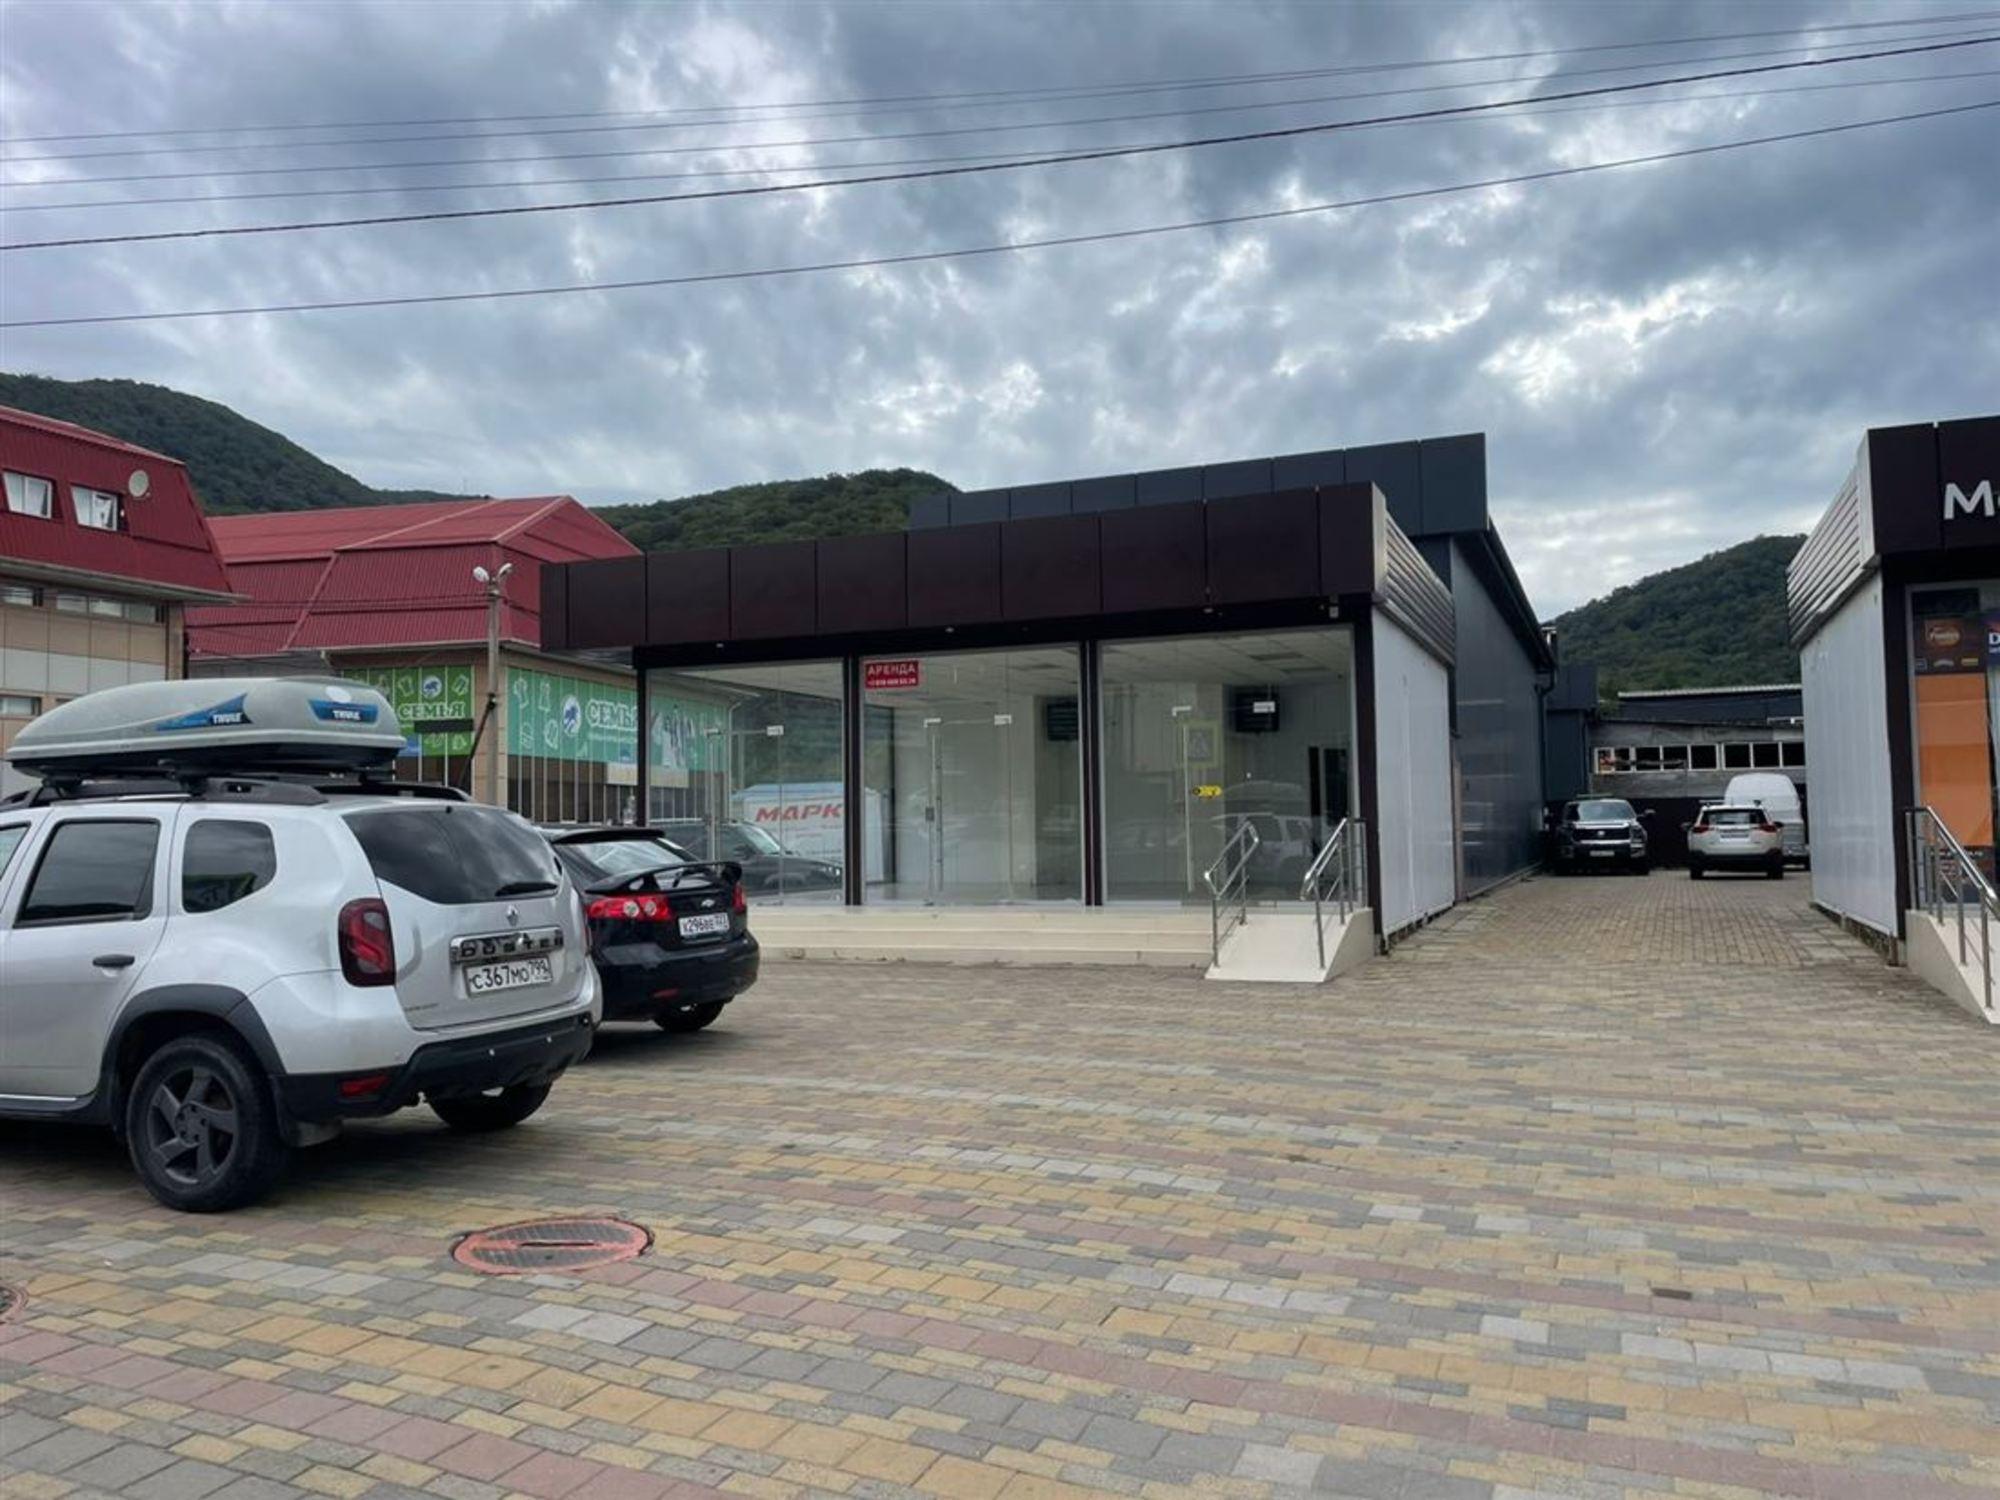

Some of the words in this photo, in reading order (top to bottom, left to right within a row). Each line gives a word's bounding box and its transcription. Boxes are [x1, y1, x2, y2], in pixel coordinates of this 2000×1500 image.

[1944, 479, 2000, 521] M
[867, 662, 917, 675] АРЕНДА
[332, 709, 361, 721] THULE
[398, 701, 466, 720] СЕМЬЯ
[212, 712, 242, 724] THULE
